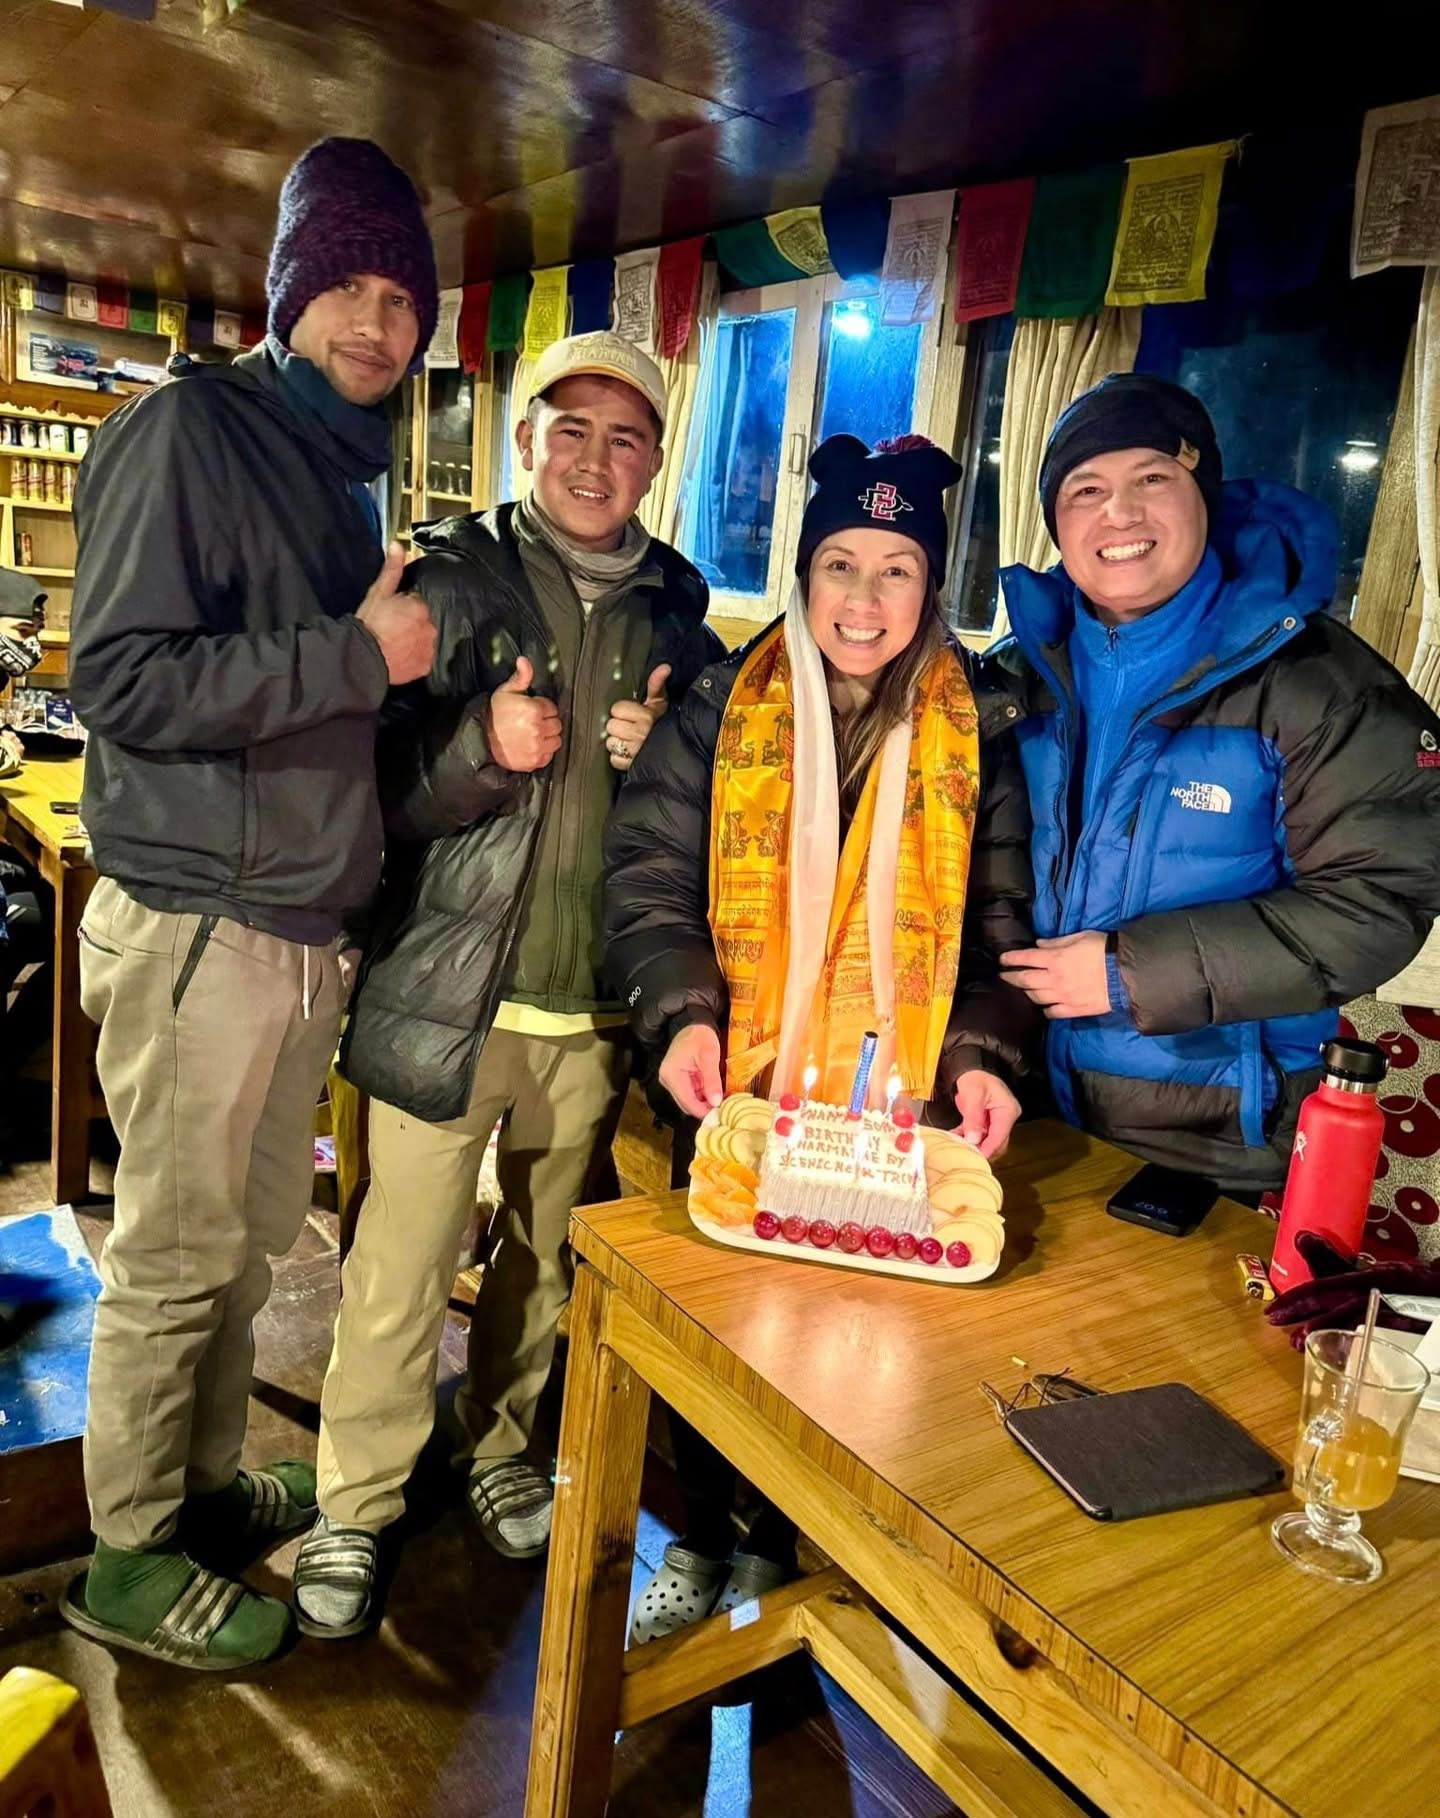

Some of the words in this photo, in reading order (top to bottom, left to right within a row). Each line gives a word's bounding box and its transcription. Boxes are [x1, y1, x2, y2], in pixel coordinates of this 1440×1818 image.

[1170, 787, 1210, 803] NORTH
[1189, 781, 1213, 793] THE
[1182, 798, 1210, 811] FACE
[805, 1127, 880, 1151] BIRTHY
[886, 1153, 907, 1169] BY
